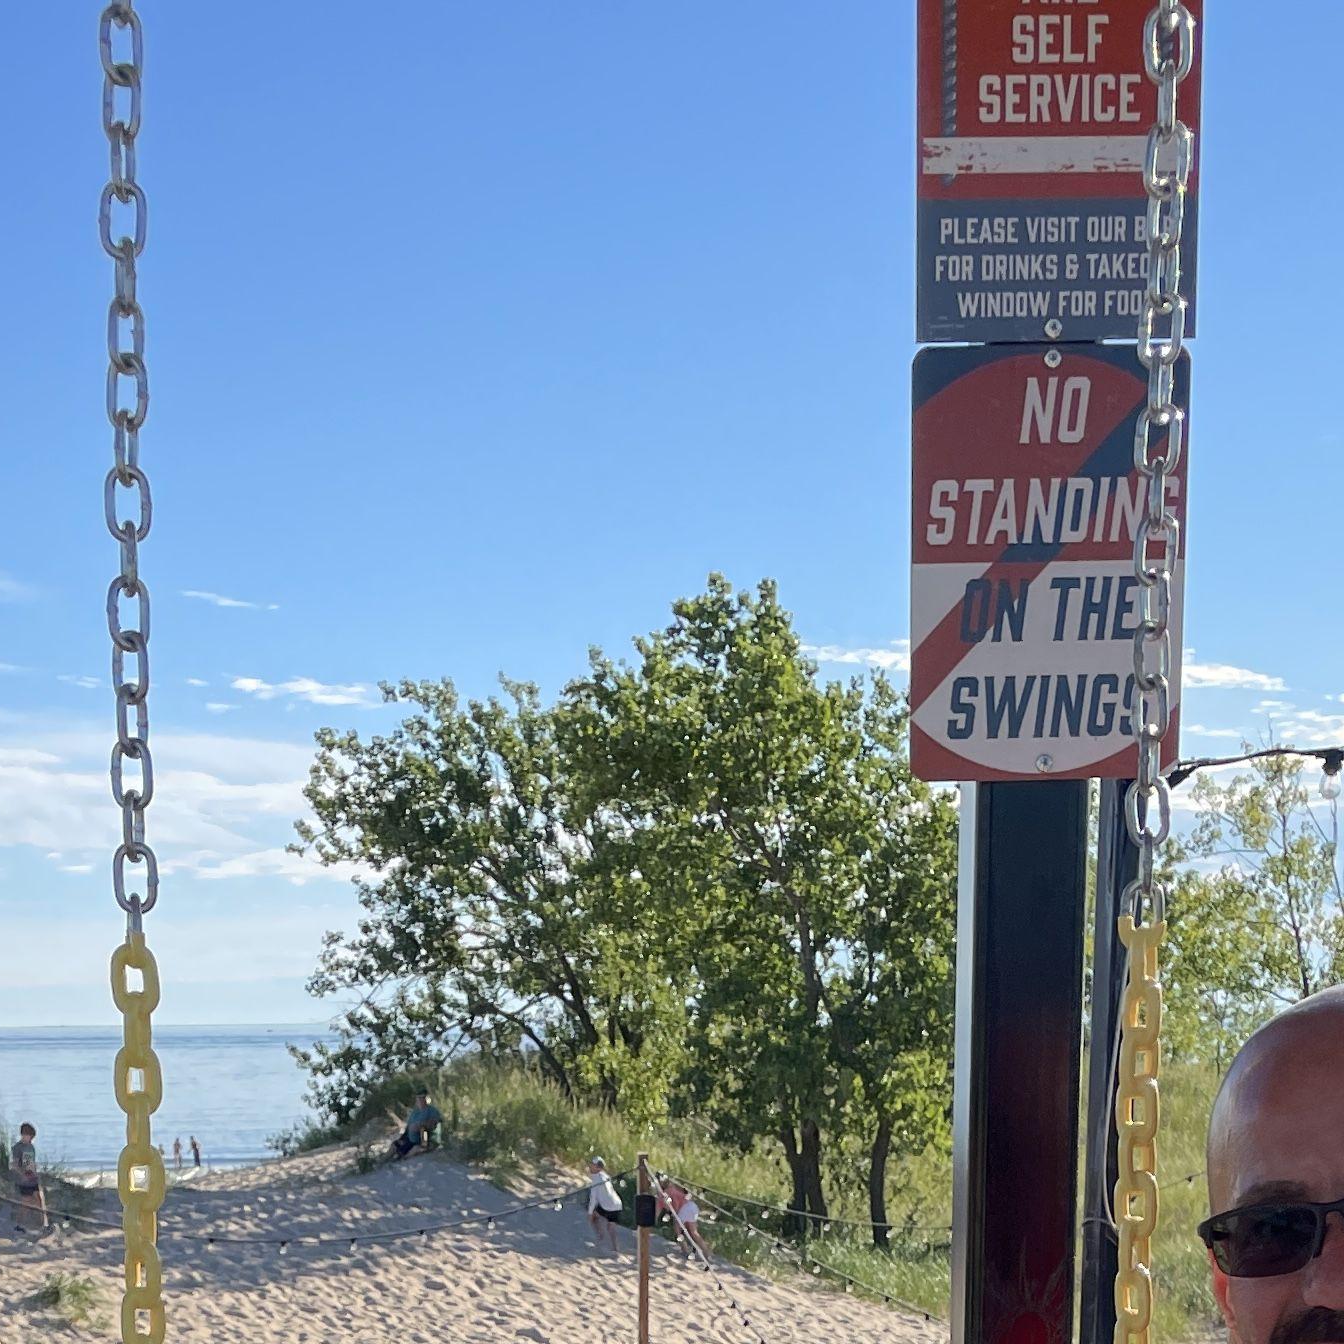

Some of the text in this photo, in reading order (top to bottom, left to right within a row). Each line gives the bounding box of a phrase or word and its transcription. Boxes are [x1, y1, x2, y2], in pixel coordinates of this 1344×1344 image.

[1011, 14, 1109, 64] SELF
[978, 73, 1142, 123] SERVICE
[940, 215, 1174, 245] PLEASE VISIT OUR BR
[934, 255, 973, 282] FOR
[981, 254, 1058, 281] DRINKS
[1064, 254, 1079, 280] &
[957, 291, 1050, 319] WINDOW
[1058, 290, 1096, 317] FOR
[1018, 376, 1090, 445] NO
[926, 475, 1181, 547] STANDING
[959, 574, 1137, 645] ON THE
[946, 673, 1150, 741] SWINGS
